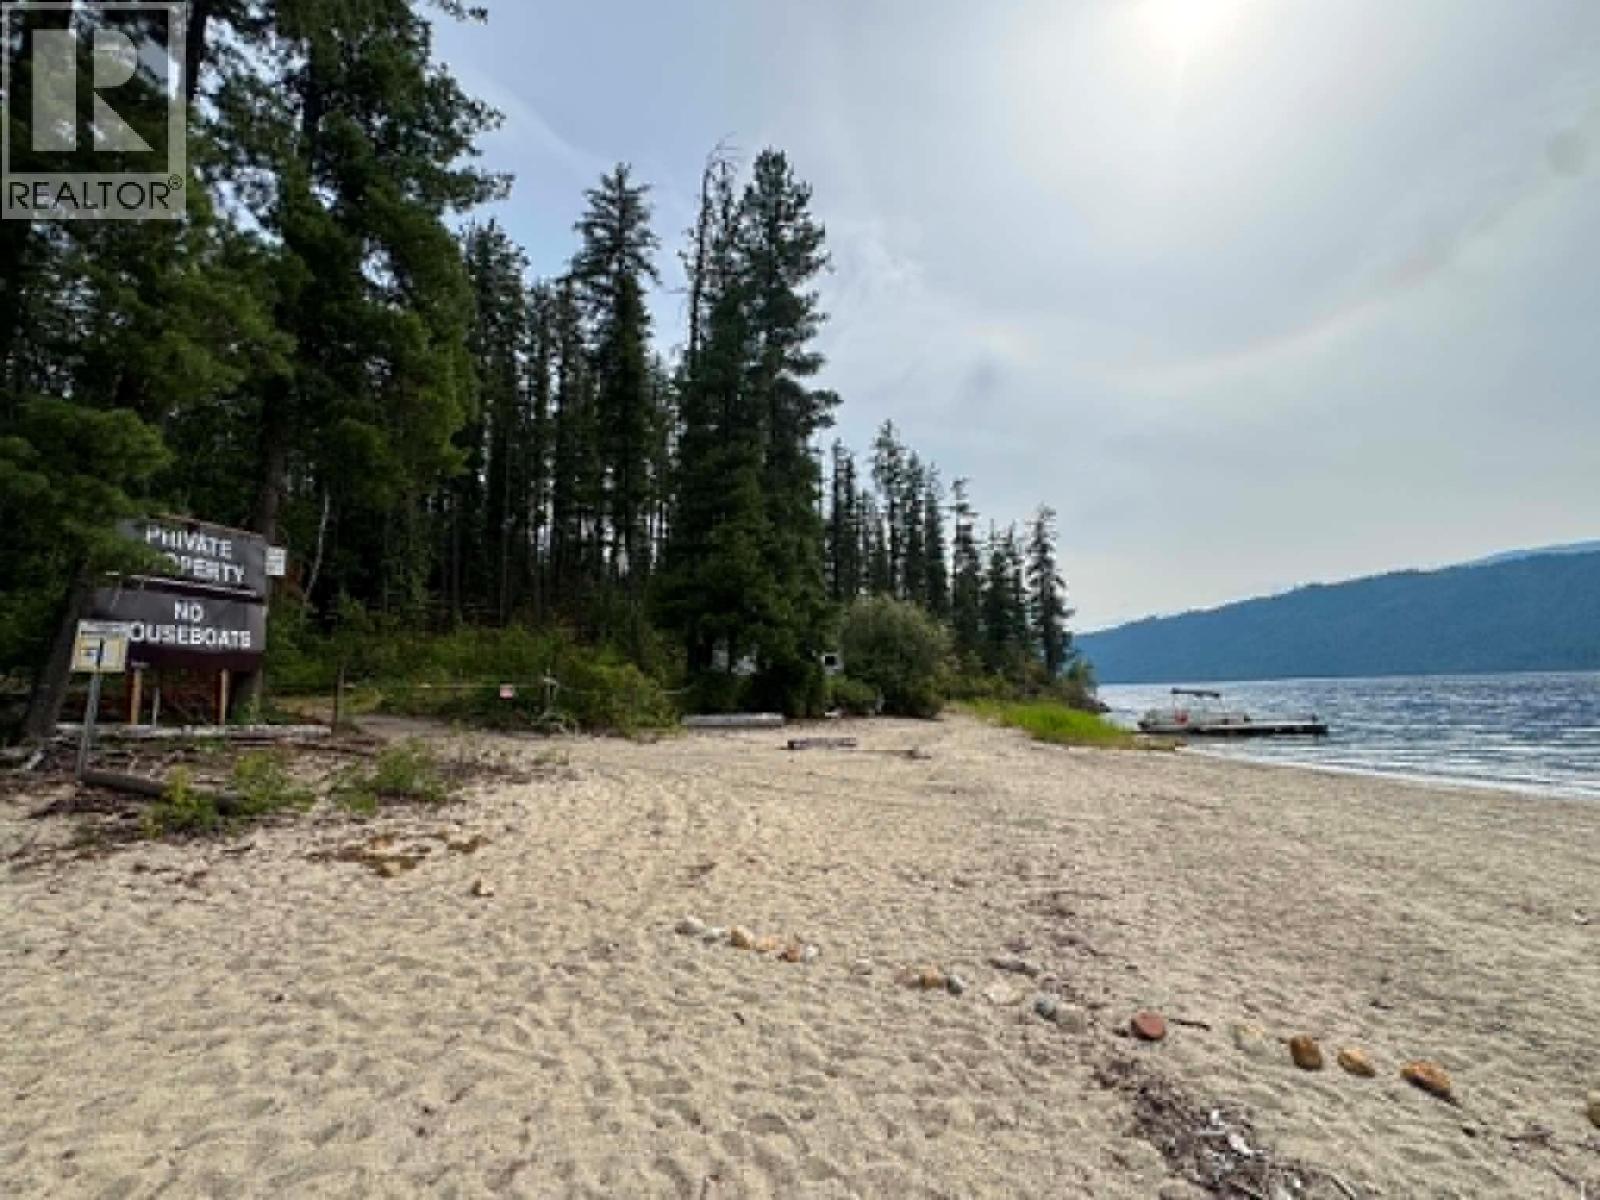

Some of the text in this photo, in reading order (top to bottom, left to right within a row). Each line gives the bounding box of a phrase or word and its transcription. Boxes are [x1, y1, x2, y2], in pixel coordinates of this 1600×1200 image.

[145, 524, 232, 560] PRIVATE
[174, 600, 204, 622] NO
[130, 621, 250, 649] OUSEBOATS
